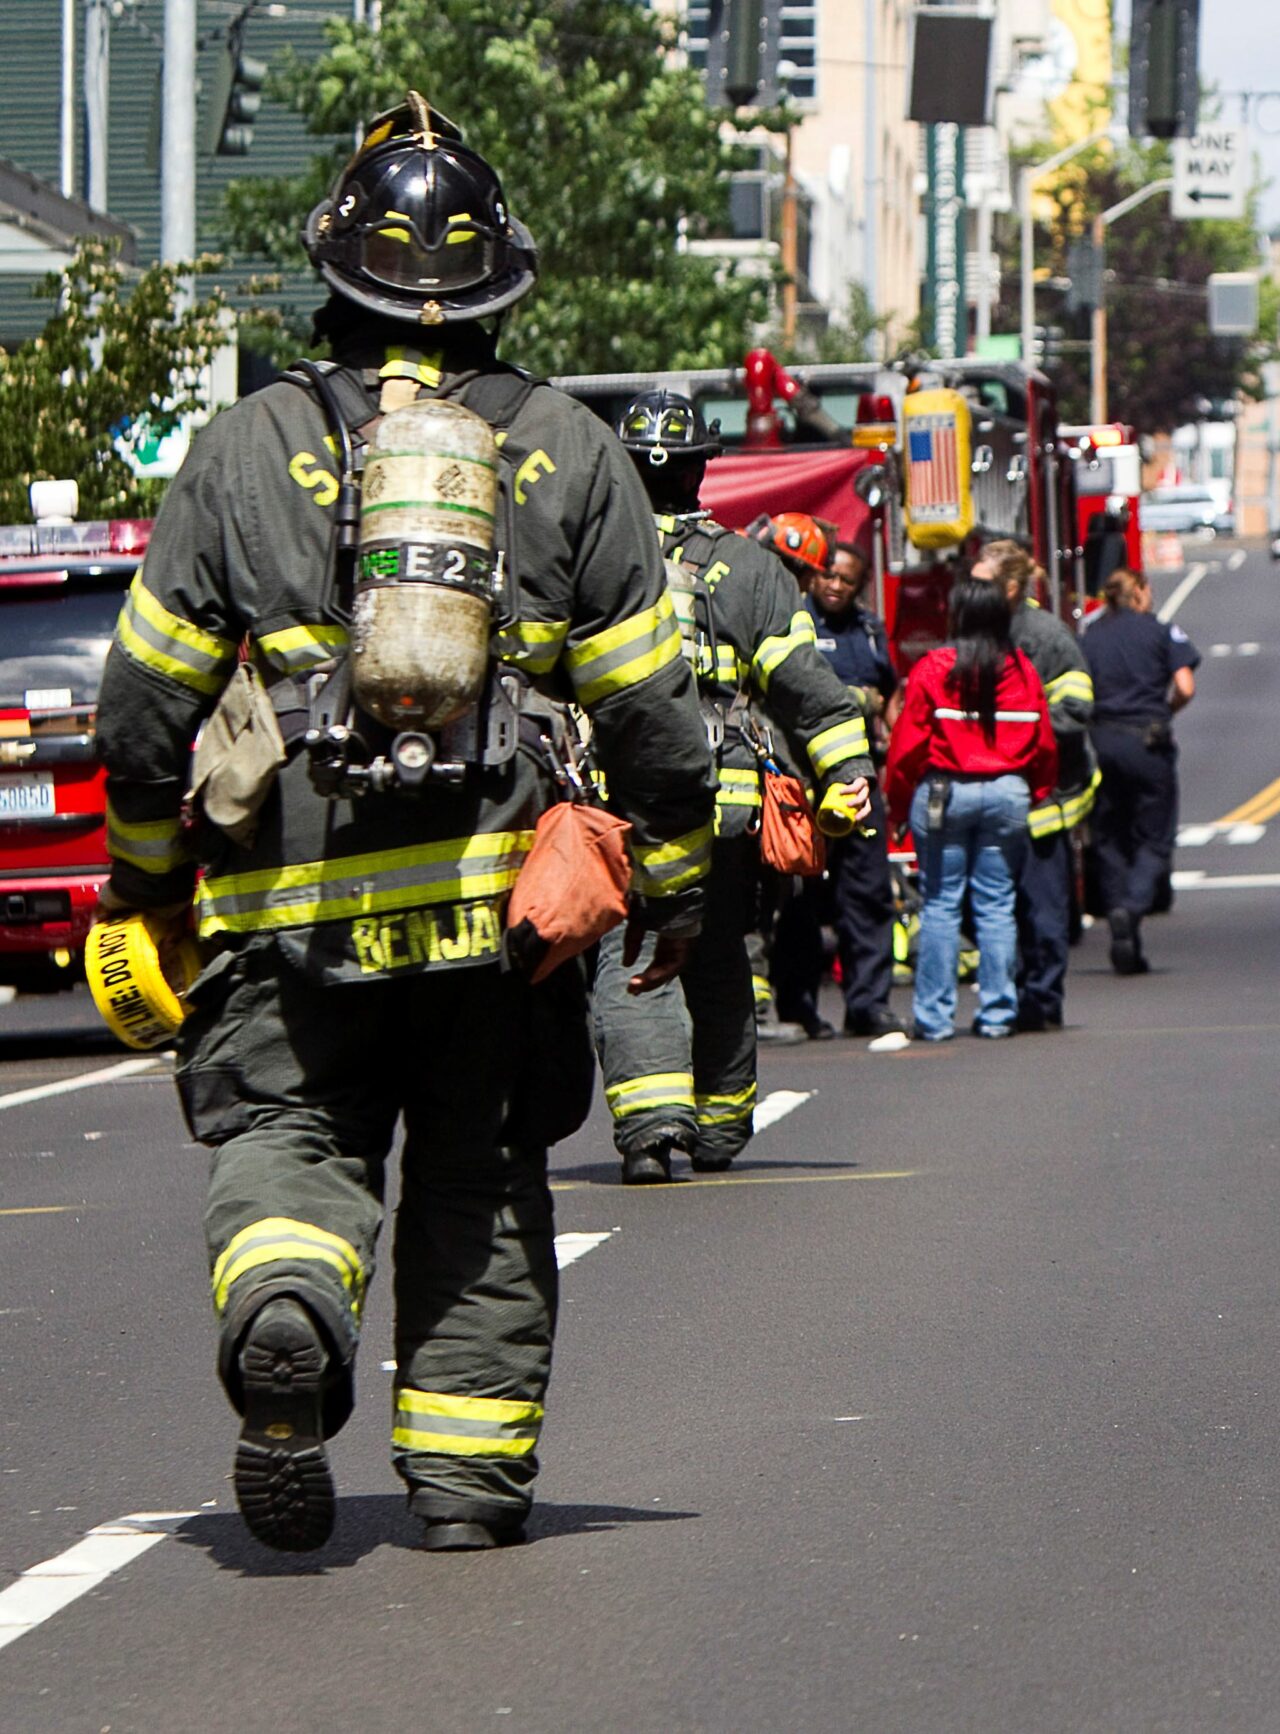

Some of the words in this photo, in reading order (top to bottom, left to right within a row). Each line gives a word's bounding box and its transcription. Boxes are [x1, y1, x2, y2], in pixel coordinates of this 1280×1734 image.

[1188, 132, 1236, 151] ONE
[1187, 159, 1235, 176] WAY
[339, 195, 356, 217] 2
[98, 926, 127, 960] NOT
[351, 901, 501, 974] BENJA
[101, 959, 132, 988] DO
